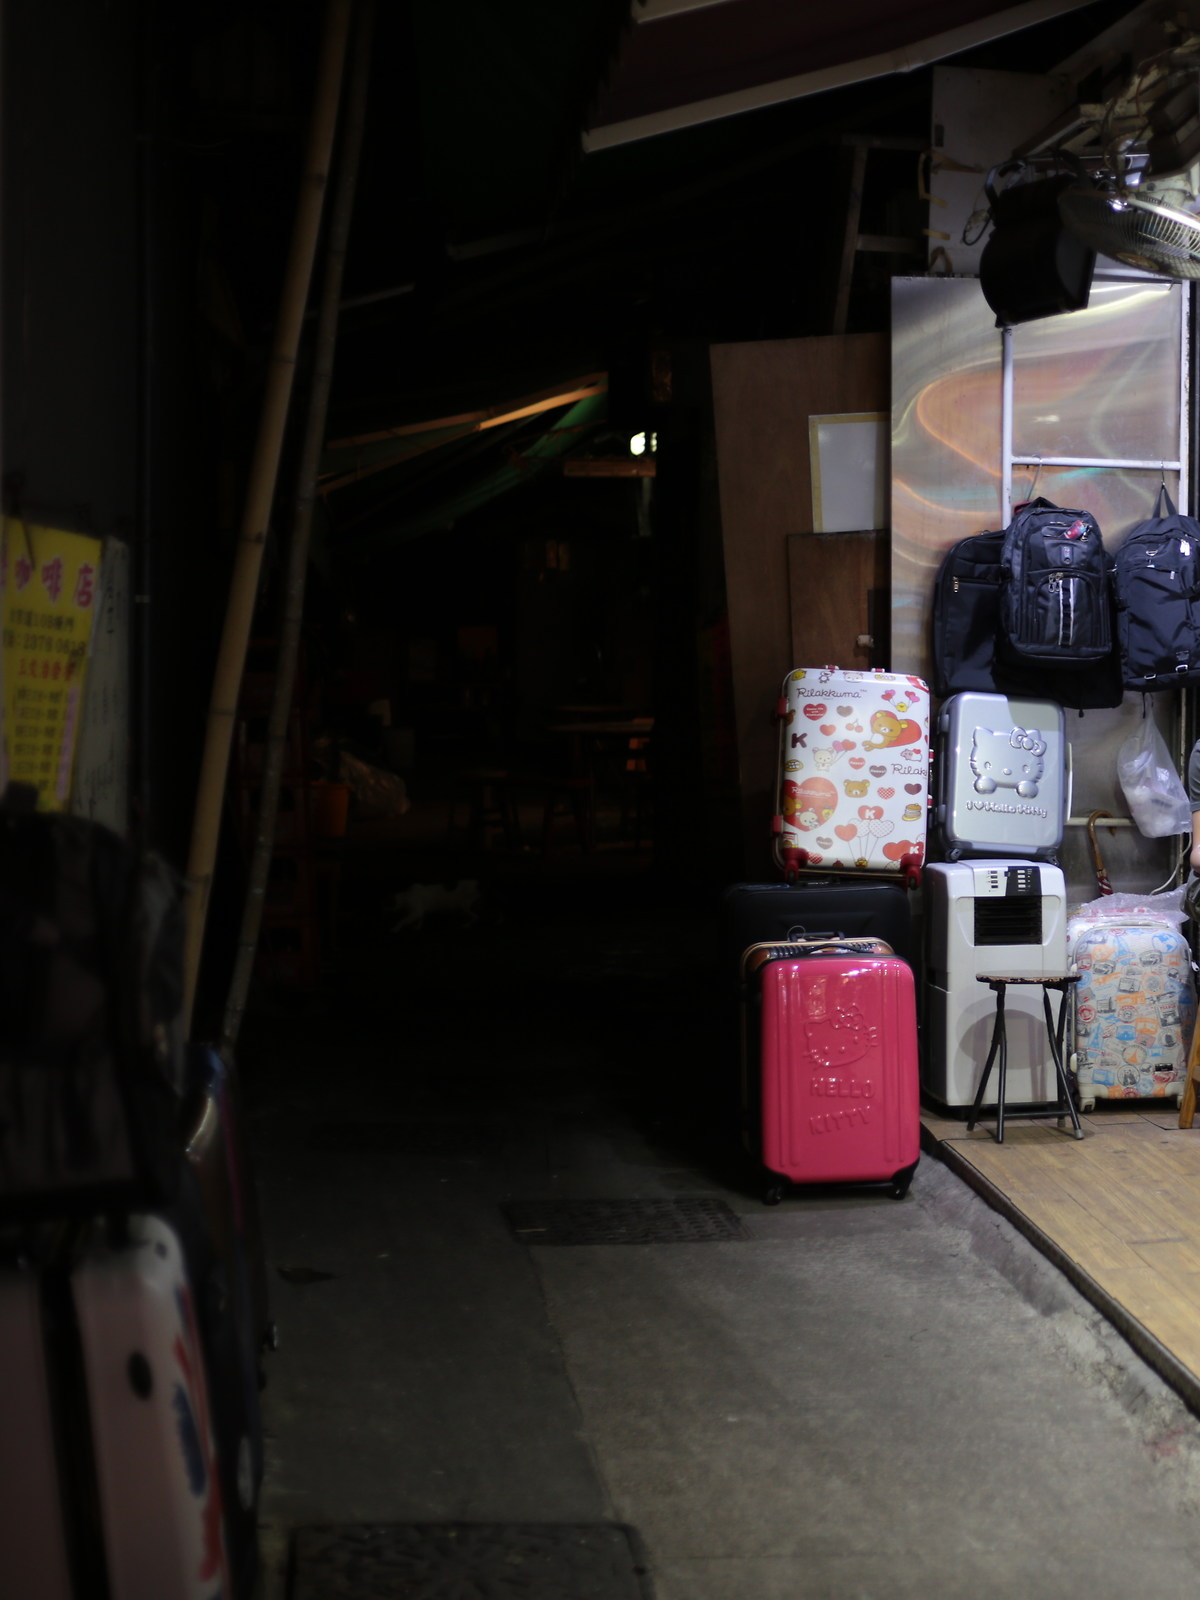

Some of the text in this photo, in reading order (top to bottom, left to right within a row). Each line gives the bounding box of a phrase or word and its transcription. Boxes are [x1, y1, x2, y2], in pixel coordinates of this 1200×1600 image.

[796, 687, 862, 699] Rilakkuma
[791, 732, 807, 749] K
[864, 809, 875, 819] K
[985, 801, 1017, 813] Hello
[1017, 804, 1048, 818] Kitty
[909, 845, 920, 855] K
[810, 1077, 875, 1099] HELLO
[808, 1105, 871, 1135] KITTY
